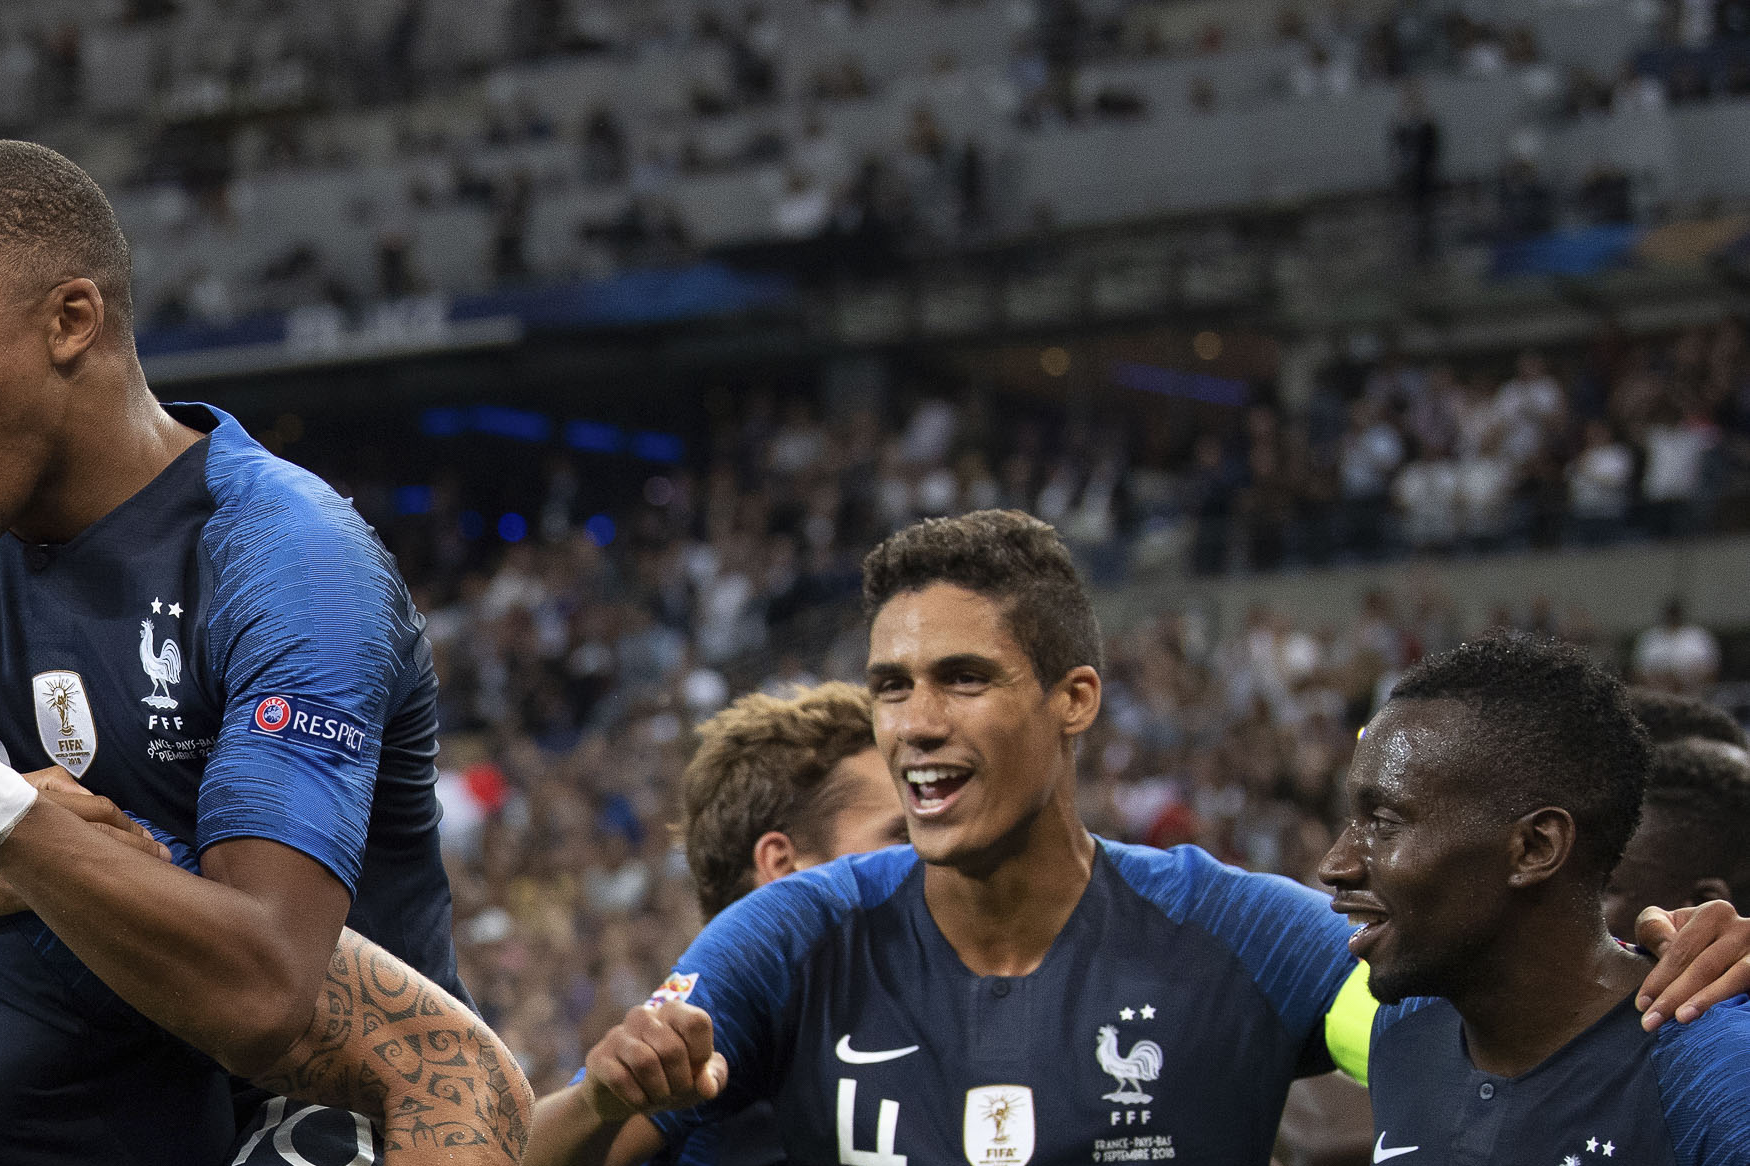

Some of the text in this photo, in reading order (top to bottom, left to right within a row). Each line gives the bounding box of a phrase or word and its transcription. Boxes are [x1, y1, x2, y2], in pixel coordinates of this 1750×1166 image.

[265, 699, 286, 709] UEFA
[293, 711, 366, 752] RESPECT
[58, 739, 83, 752] FIFA
[67, 757, 82, 765] 2018
[986, 1147, 1015, 1158] FIFA
[1092, 1146, 1175, 1162] 9 SEPTEMBRE 2018
